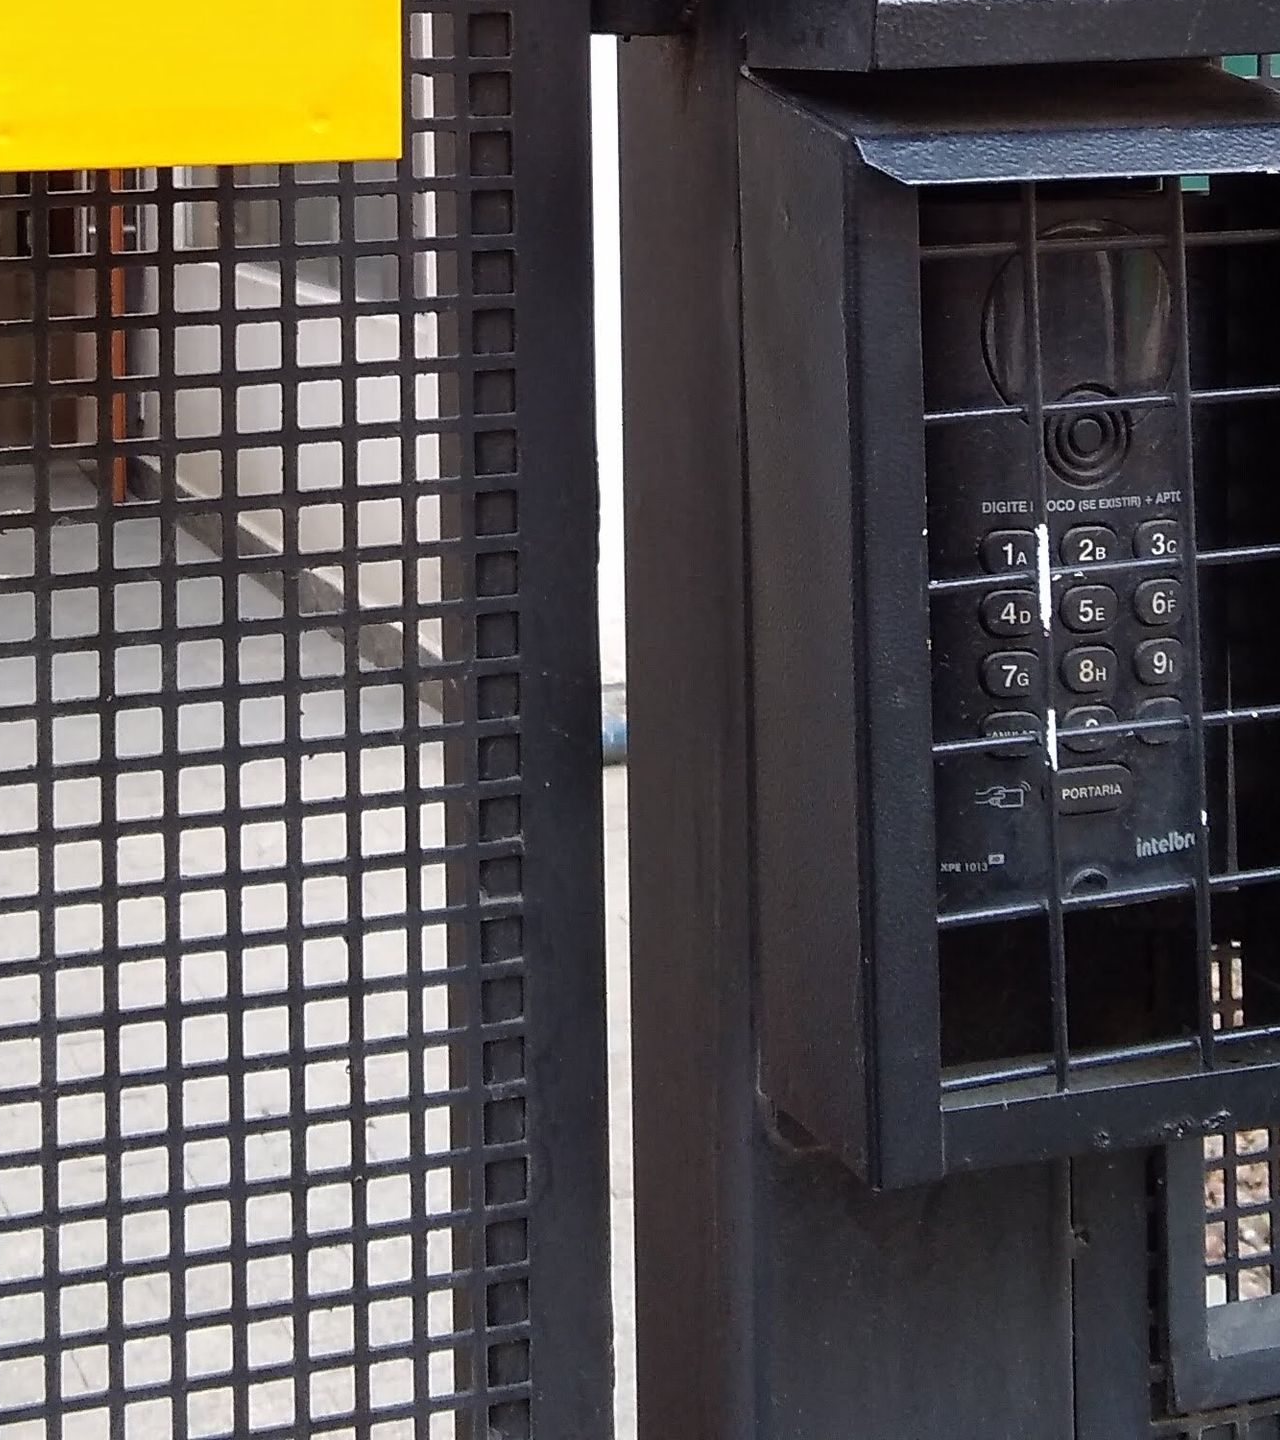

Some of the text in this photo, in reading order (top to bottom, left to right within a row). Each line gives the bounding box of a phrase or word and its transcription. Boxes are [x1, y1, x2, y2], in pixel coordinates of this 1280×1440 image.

[982, 500, 1027, 514] DIGITE
[1078, 499, 1097, 513] (SE
[1099, 496, 1141, 510] EXISTIR)
[1145, 495, 1153, 505] +
[1062, 783, 1123, 800] PORTARIA
